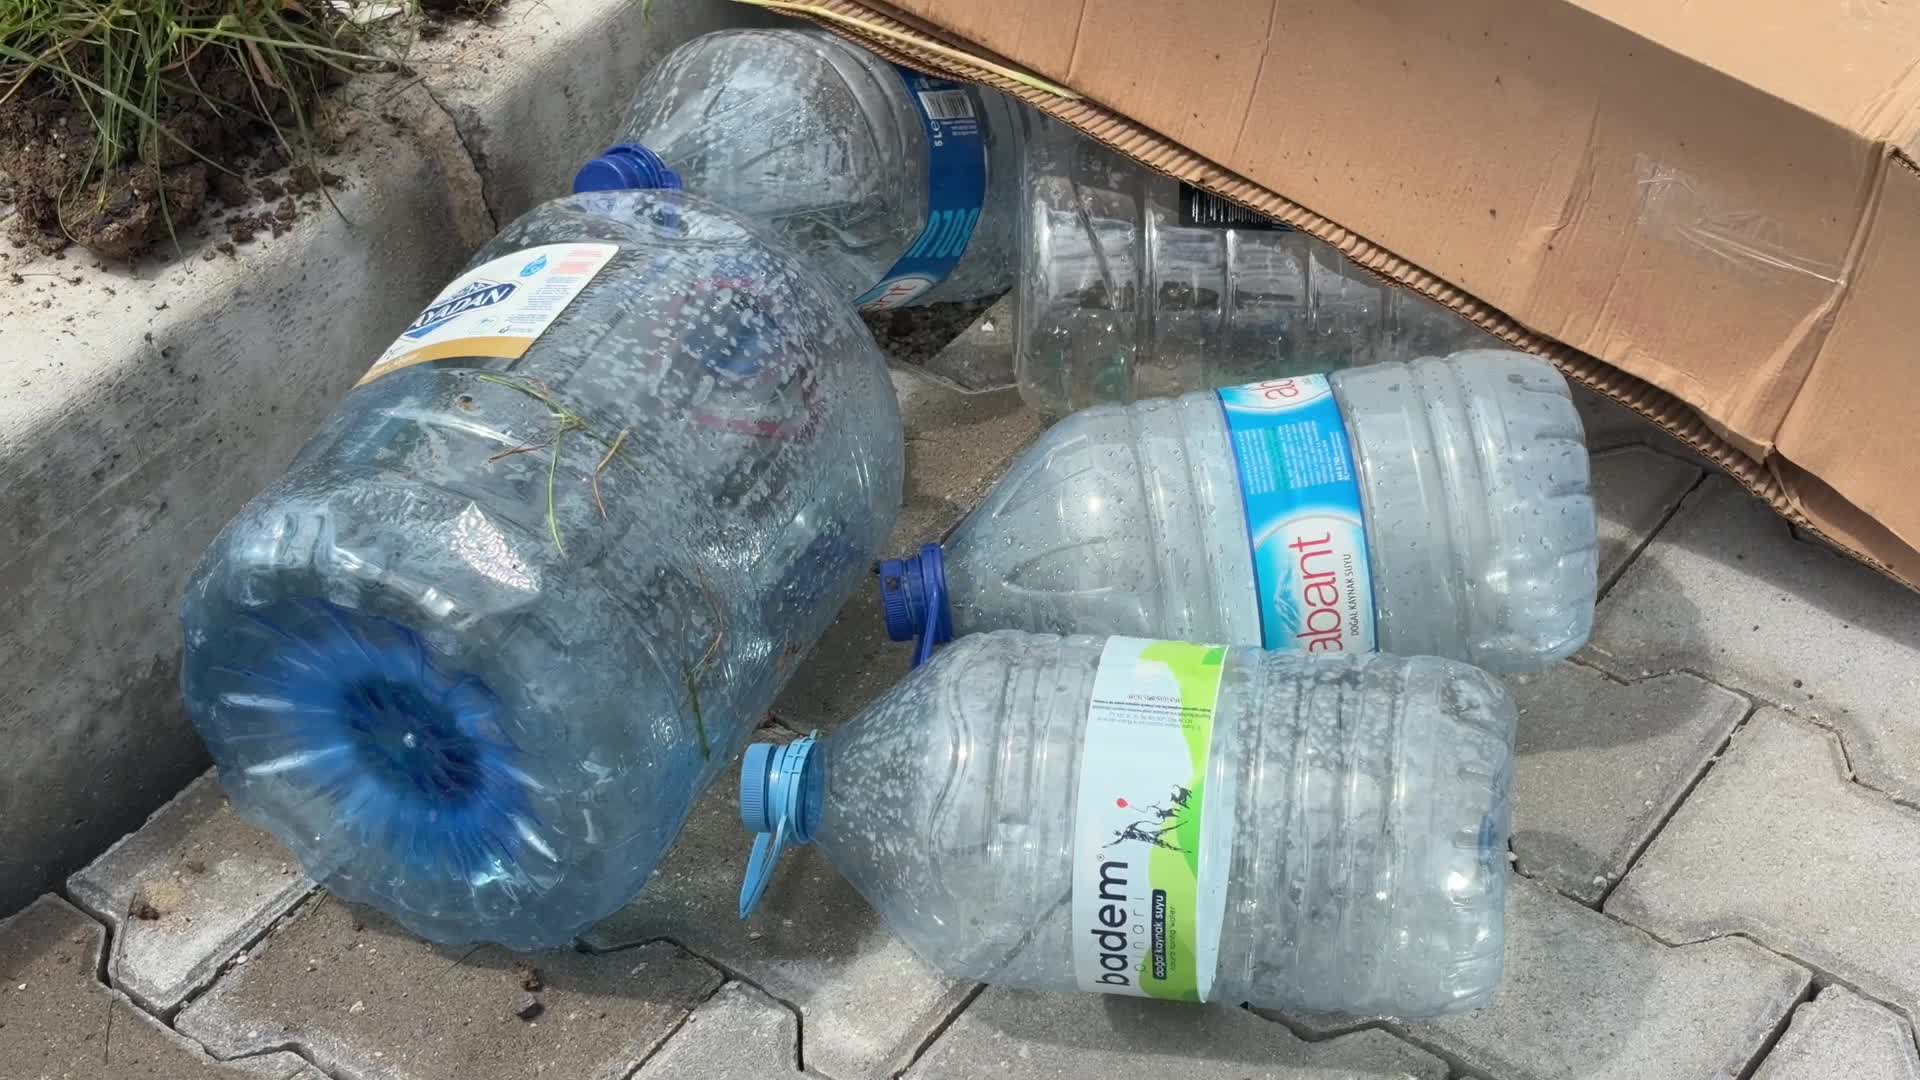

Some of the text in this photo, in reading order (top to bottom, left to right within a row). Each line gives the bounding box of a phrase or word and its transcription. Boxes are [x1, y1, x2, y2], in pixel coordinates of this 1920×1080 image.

[1288, 531, 1344, 652] abant
[1343, 553, 1360, 637] DOĞAL KAYNAK SUYU
[1091, 861, 1131, 986] badem
[1153, 921, 1164, 954] kaynak
[1155, 894, 1166, 919] suyu
